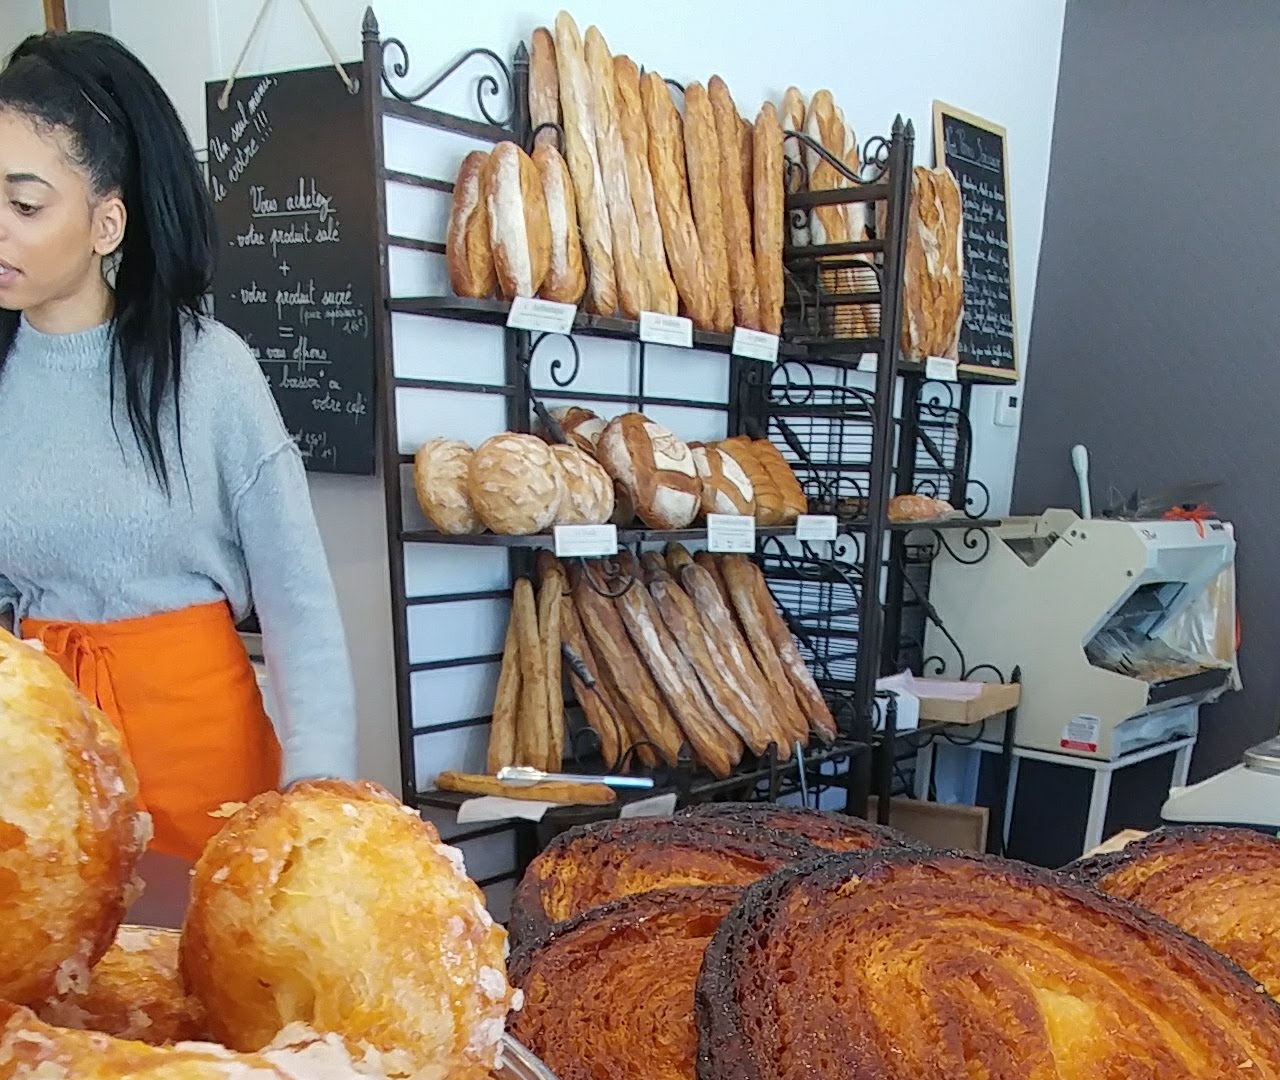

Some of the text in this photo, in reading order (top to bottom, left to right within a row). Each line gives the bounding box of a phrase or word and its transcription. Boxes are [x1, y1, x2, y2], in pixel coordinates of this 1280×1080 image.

[250, 176, 333, 223] Vous achetez
[235, 222, 266, 248] votre
[270, 221, 313, 259] produit
[315, 215, 341, 243] salé
[240, 280, 268, 305] votre
[275, 278, 317, 321] produit
[311, 391, 342, 413] votre
